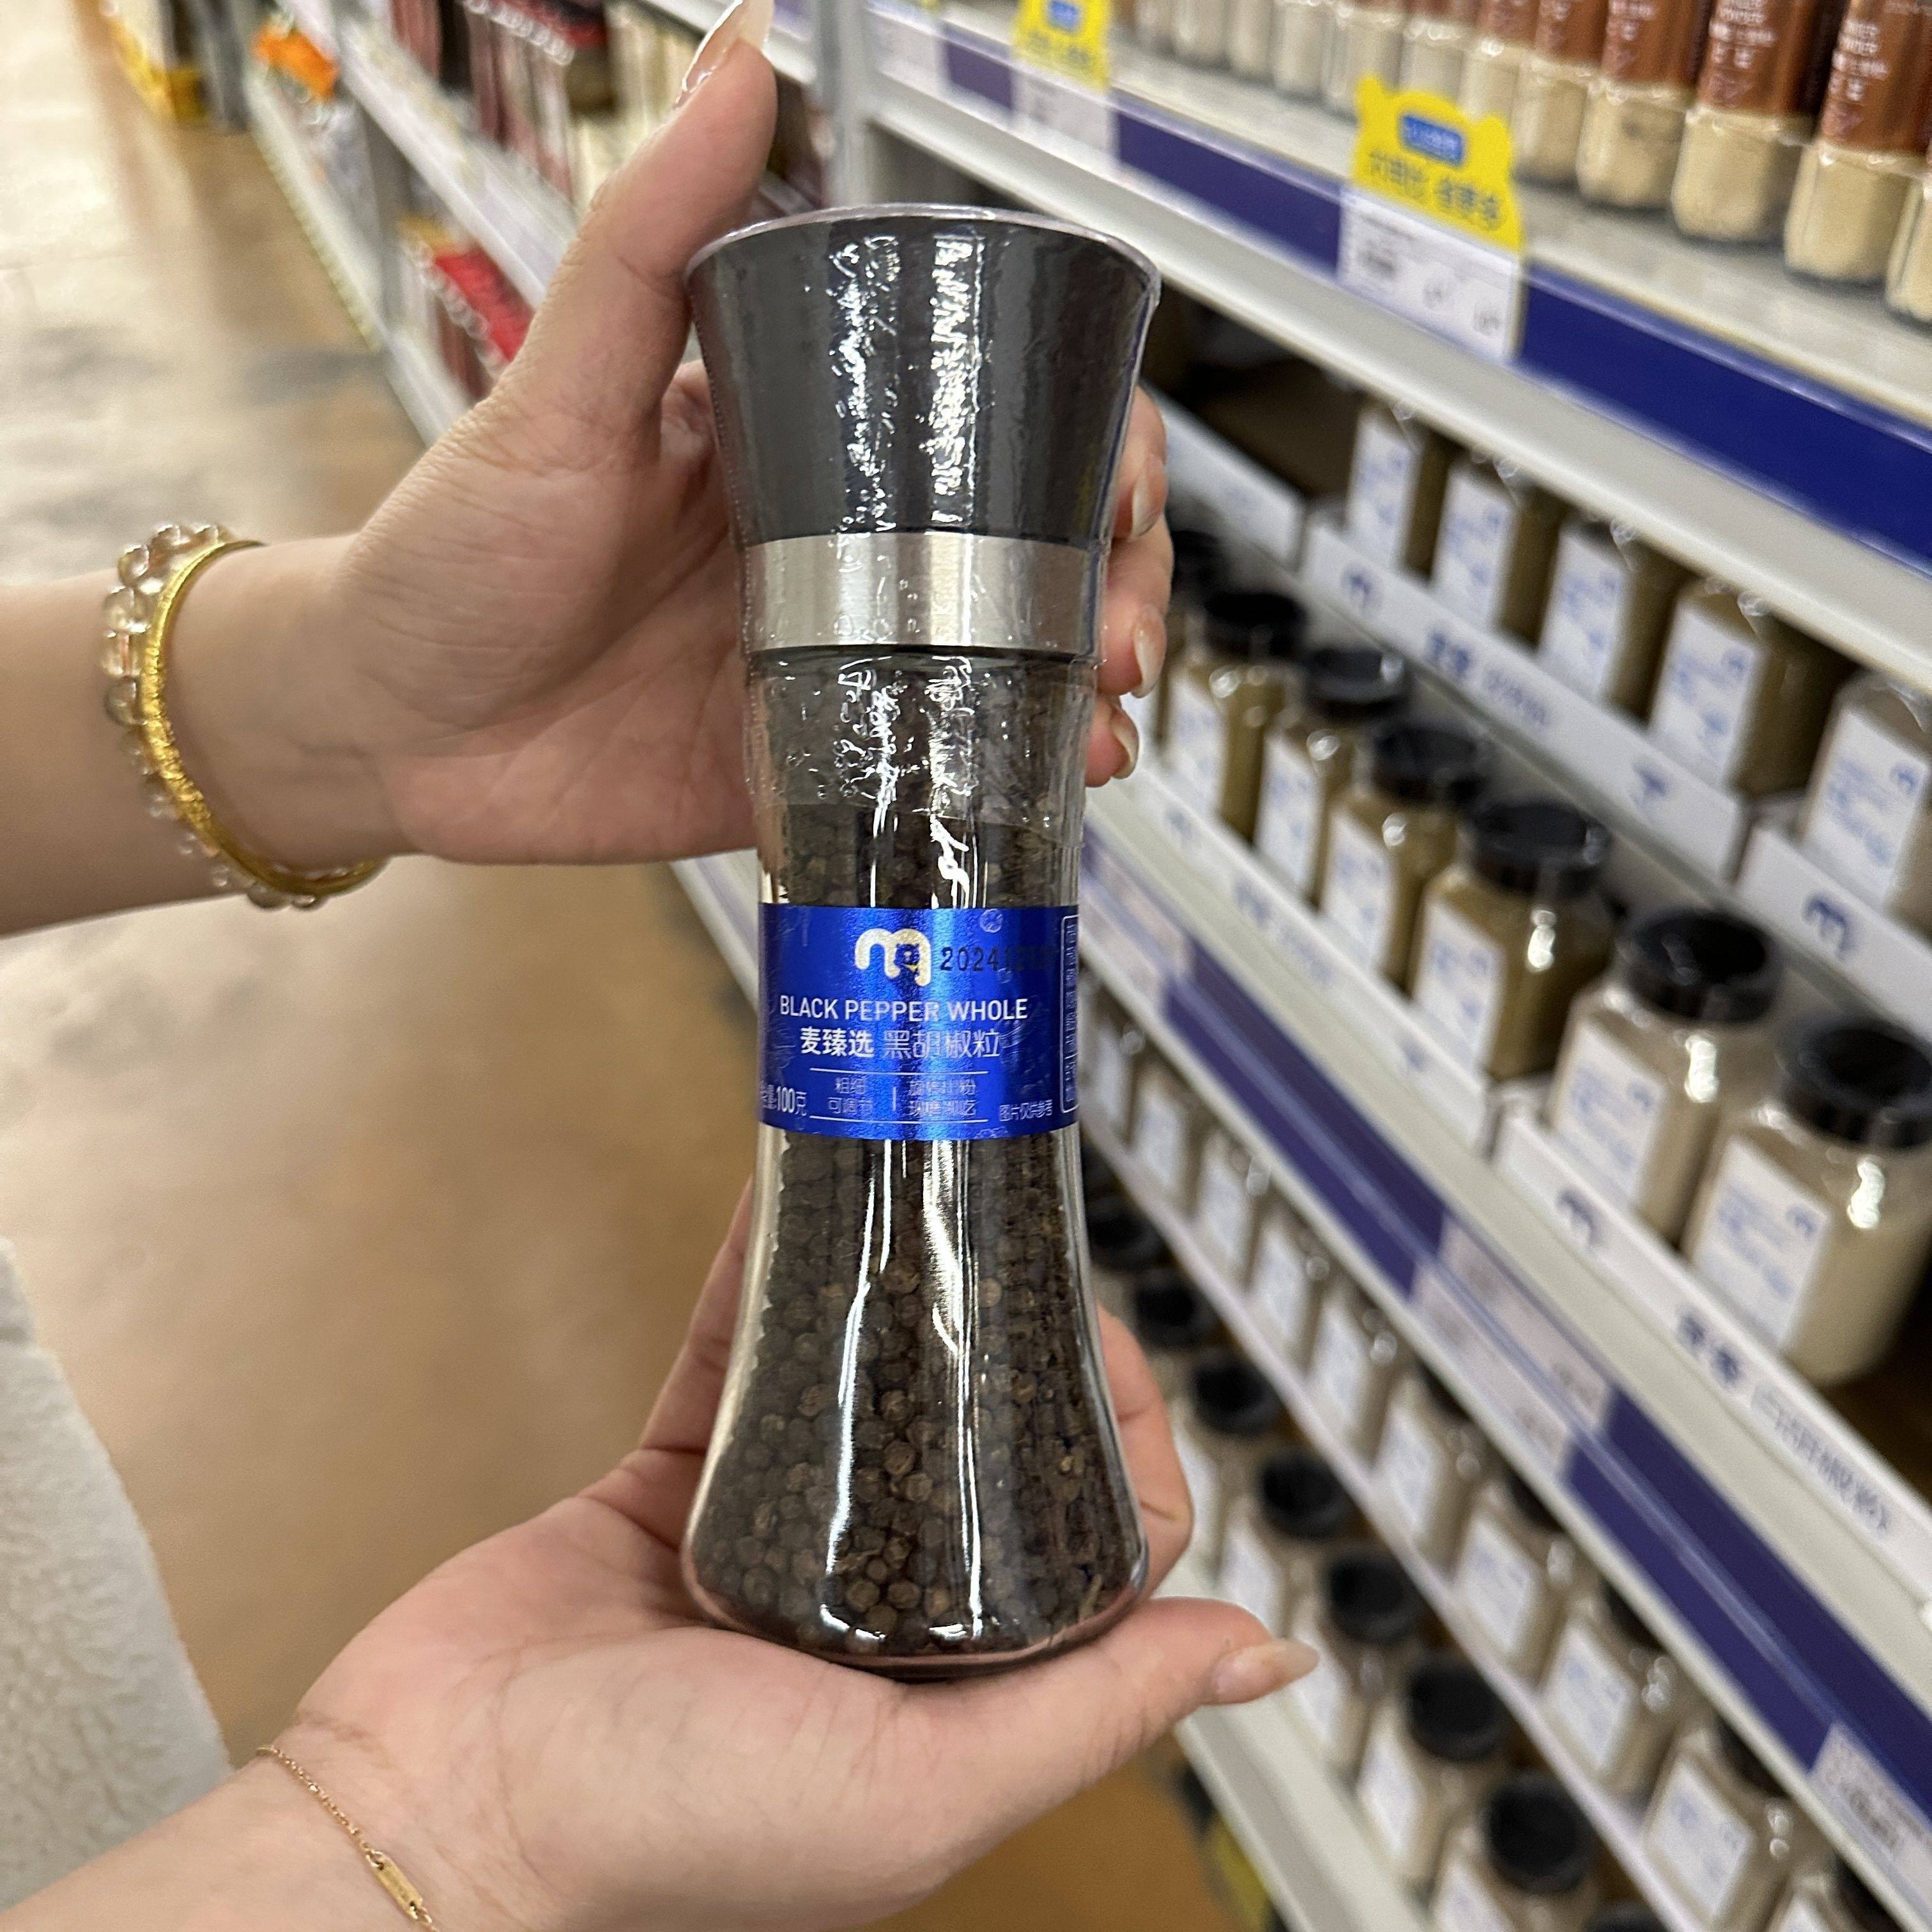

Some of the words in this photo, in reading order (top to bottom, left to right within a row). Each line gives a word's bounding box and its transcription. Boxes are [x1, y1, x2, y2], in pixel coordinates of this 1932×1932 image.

[780, 995, 839, 1020] BLACK
[845, 999, 940, 1022] PEPPER
[947, 998, 1028, 1021] WHOLE
[800, 1026, 875, 1058] 麦臻选
[884, 1028, 1001, 1059] 黑胡椒粒
[835, 1077, 866, 1094] 粗细
[827, 1096, 873, 1116] 可调节
